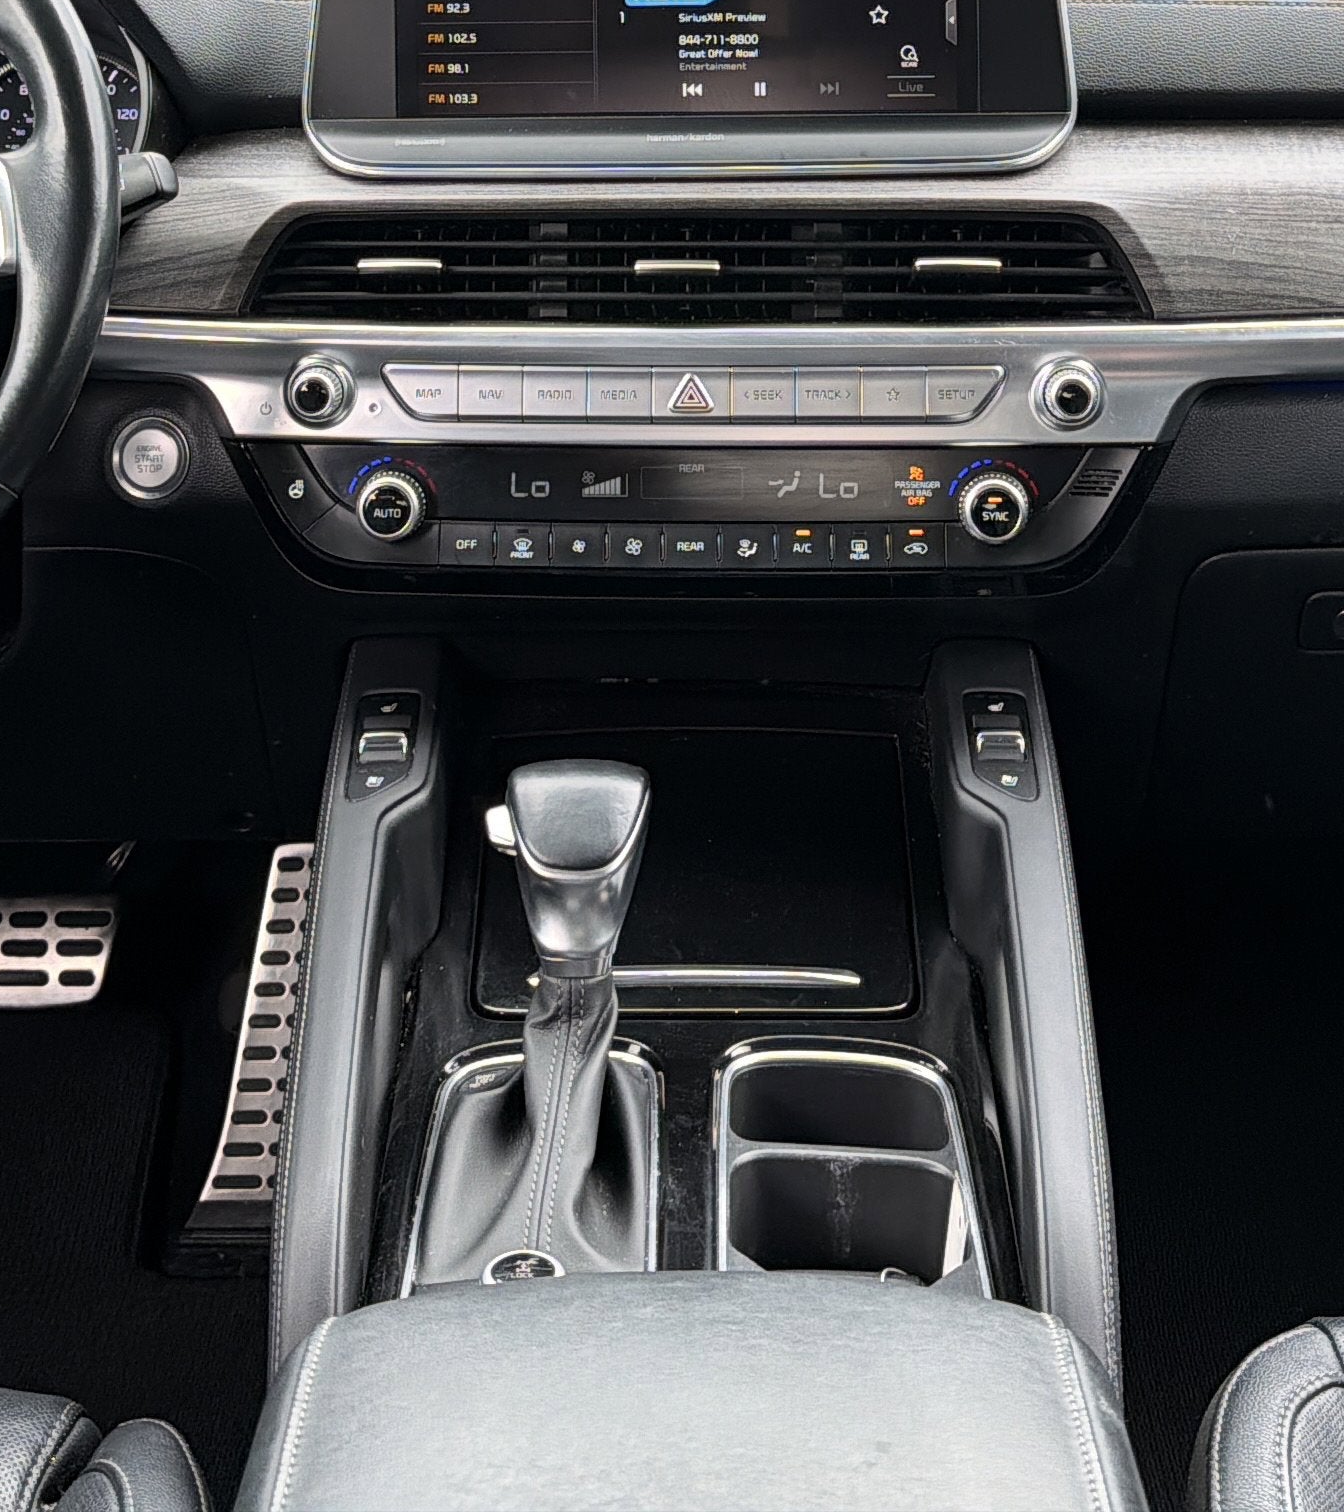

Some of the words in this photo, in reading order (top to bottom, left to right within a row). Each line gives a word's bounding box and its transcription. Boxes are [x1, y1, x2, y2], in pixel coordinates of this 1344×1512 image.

[427, 3, 444, 14] FM
[446, 3, 471, 14] 92.3
[619, 11, 626, 24] 1
[678, 13, 724, 23] SiriusXM
[726, 12, 767, 23] Preview
[427, 34, 444, 43] FM
[448, 33, 477, 43] 102.5
[678, 34, 759, 46] 844-711-8800
[678, 49, 706, 58] Great
[707, 48, 734, 58] Offer
[428, 64, 445, 74] FM
[679, 62, 748, 71] Entertainment
[898, 82, 923, 92] Live
[428, 94, 445, 104] FM
[449, 94, 478, 104] 103.3
[117, 108, 139, 120] 120
[646, 133, 725, 142] harman/kardon
[416, 389, 442, 399] MAP
[478, 389, 503, 400] NAV
[537, 389, 572, 400] RADIO
[600, 389, 638, 400] MEDIA
[753, 390, 784, 401] SEEK
[805, 389, 842, 400] TRACK
[937, 389, 975, 400] SETUP
[134, 454, 164, 463] START
[136, 464, 163, 473] STOP
[679, 464, 705, 473] REAR
[510, 471, 550, 498] Lo
[819, 473, 859, 499] Lo
[894, 480, 941, 489] PASSENGER
[901, 489, 915, 497] AIR
[916, 489, 933, 497] BAG
[907, 496, 926, 506] OFF
[373, 508, 402, 519] AUTO
[982, 511, 1010, 523] SYNC
[456, 539, 478, 550] OFF
[676, 541, 704, 552] REAR
[792, 543, 813, 554] A/C
